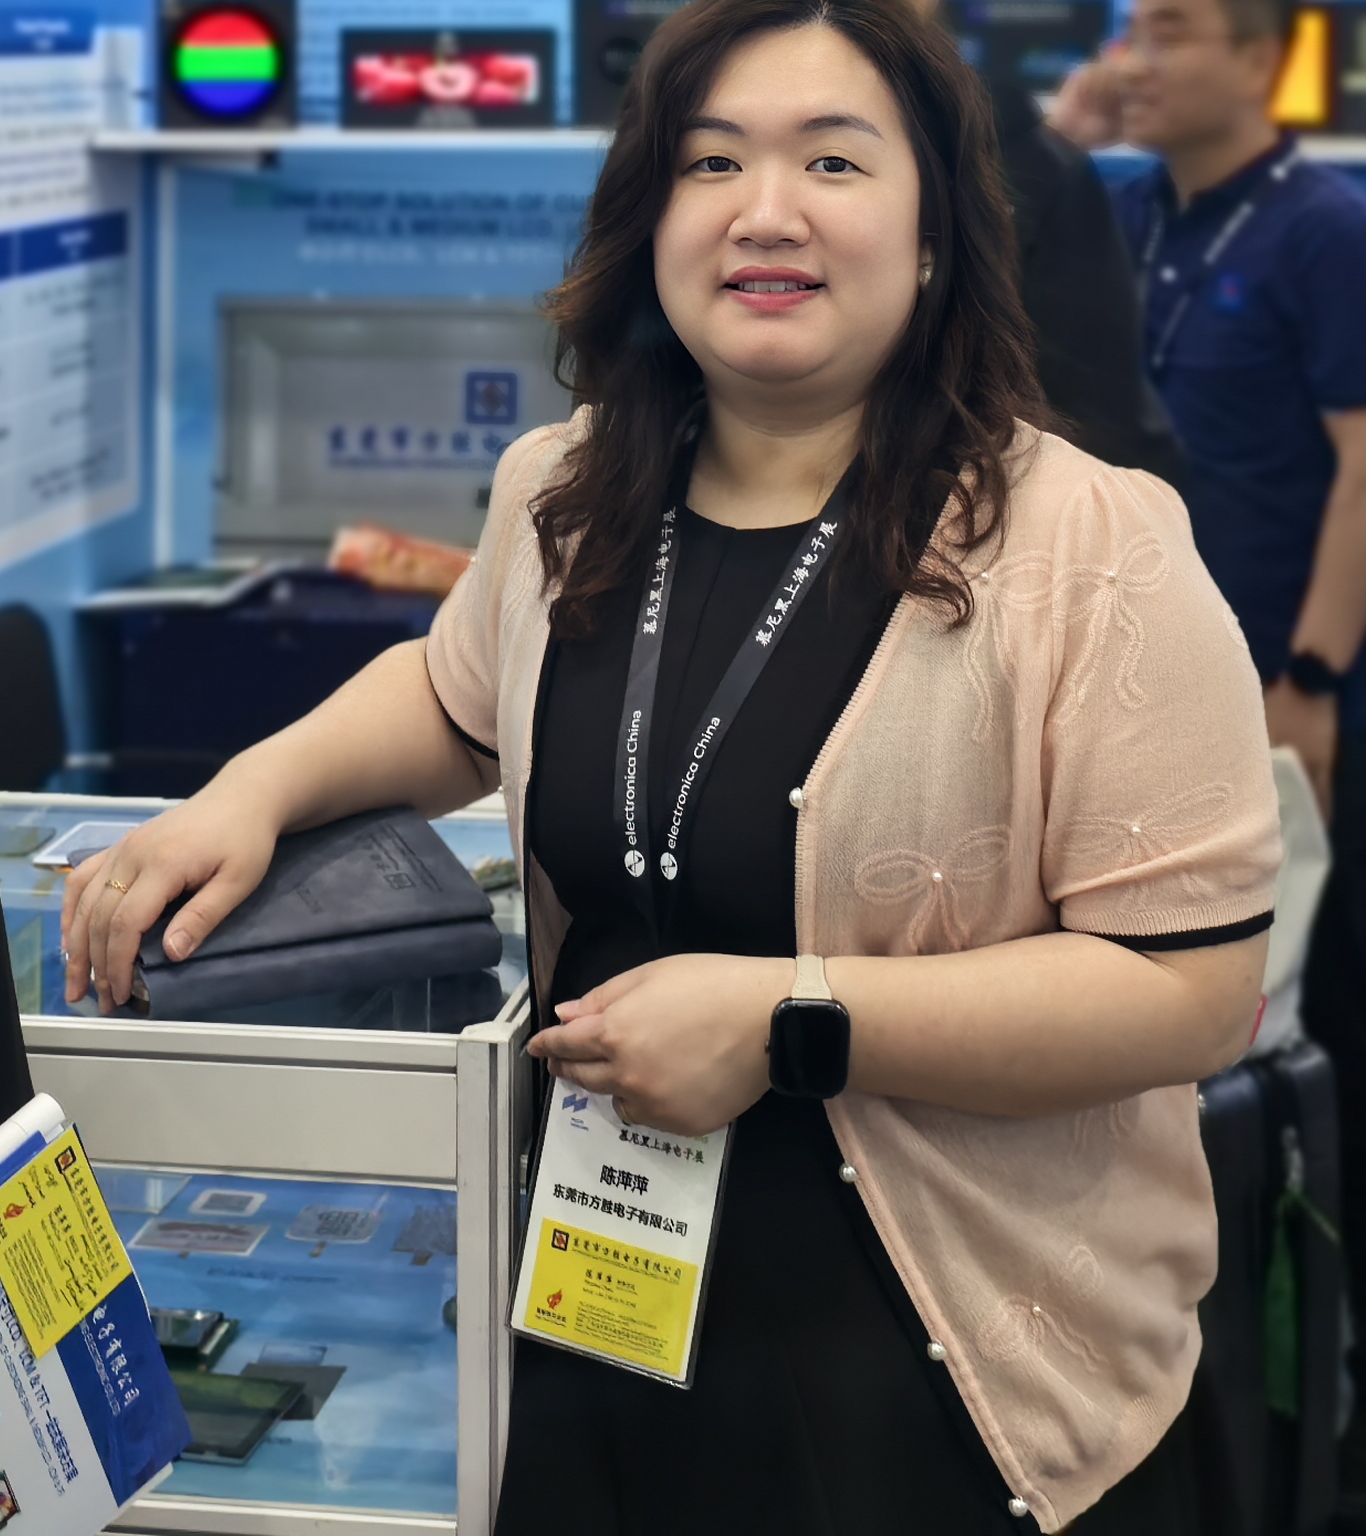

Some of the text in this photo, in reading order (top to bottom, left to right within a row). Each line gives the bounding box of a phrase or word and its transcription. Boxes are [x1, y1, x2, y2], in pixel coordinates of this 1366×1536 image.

[624, 709, 642, 846] electronica China
[666, 716, 722, 850] electronica China
[552, 1183, 689, 1237] 东莞市方胜电子有限公司
